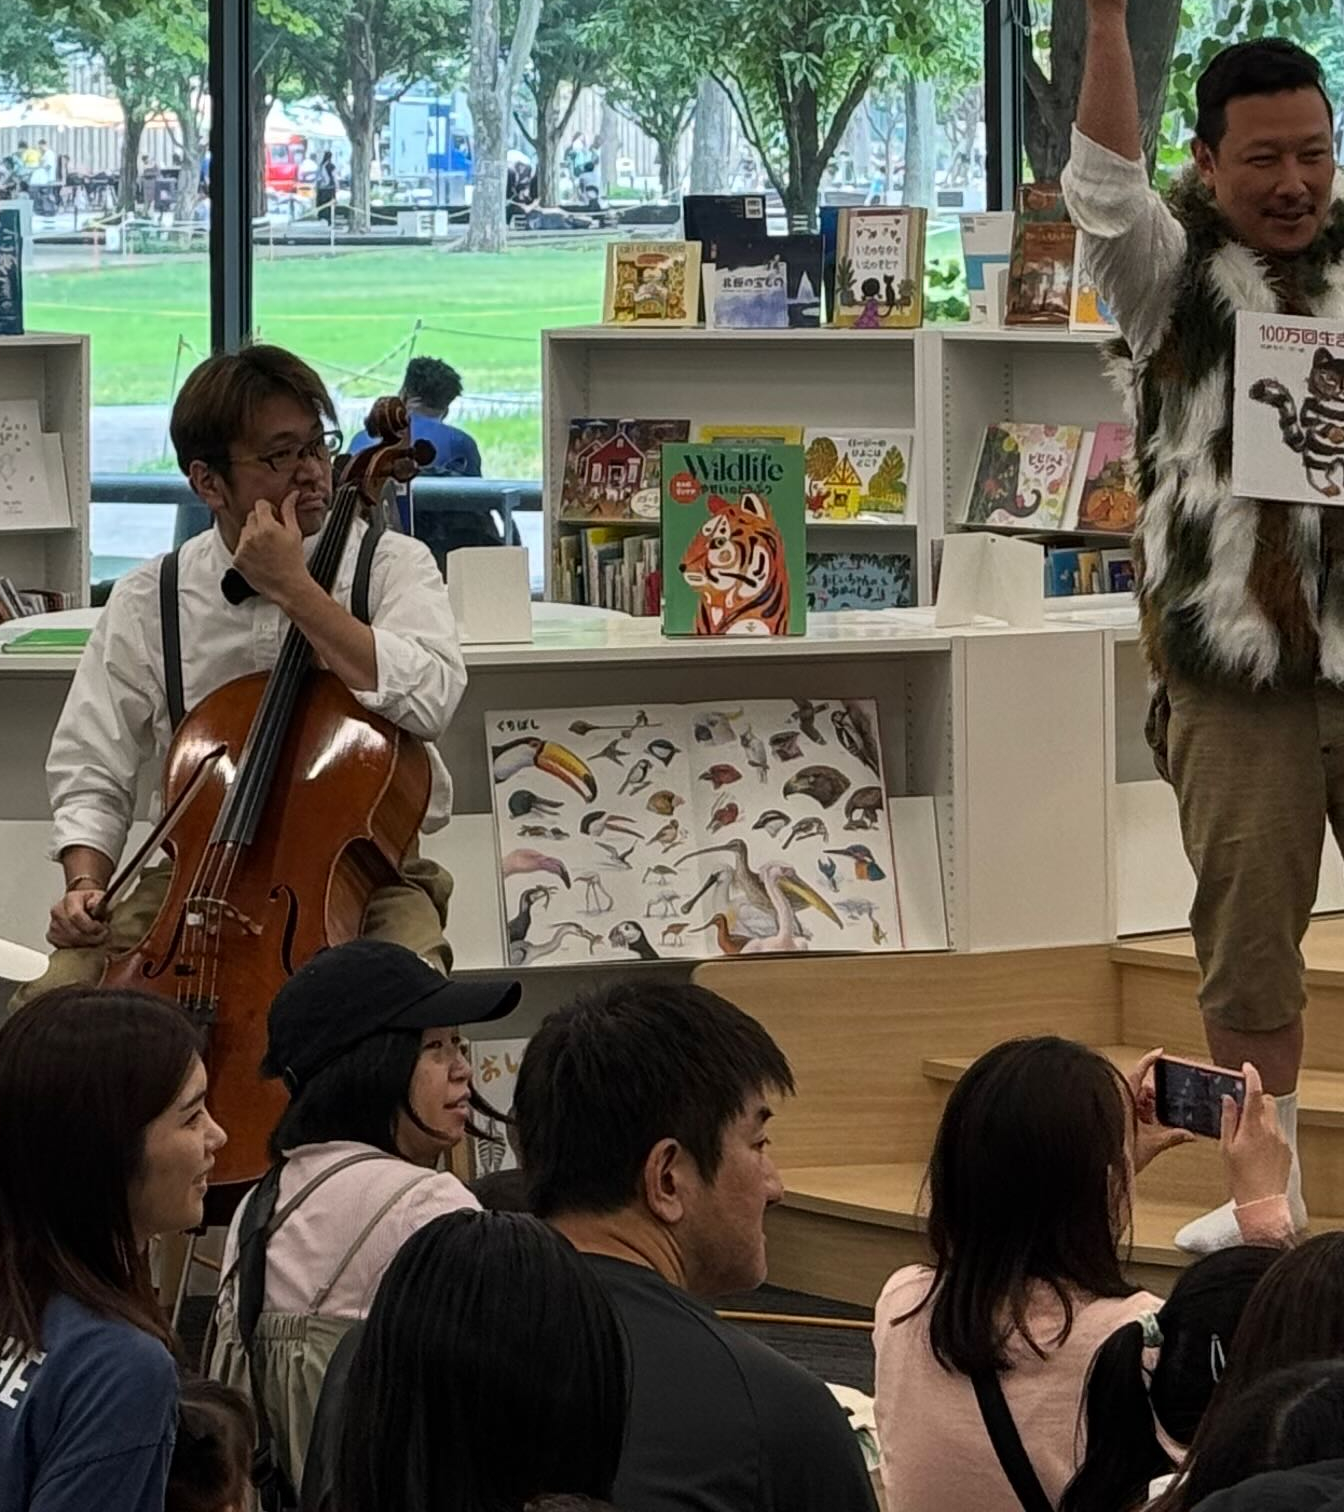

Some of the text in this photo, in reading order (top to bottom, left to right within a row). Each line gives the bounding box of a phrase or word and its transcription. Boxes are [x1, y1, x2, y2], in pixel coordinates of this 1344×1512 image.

[683, 453, 784, 481] Wildlife
[495, 719, 540, 731] くちばし
